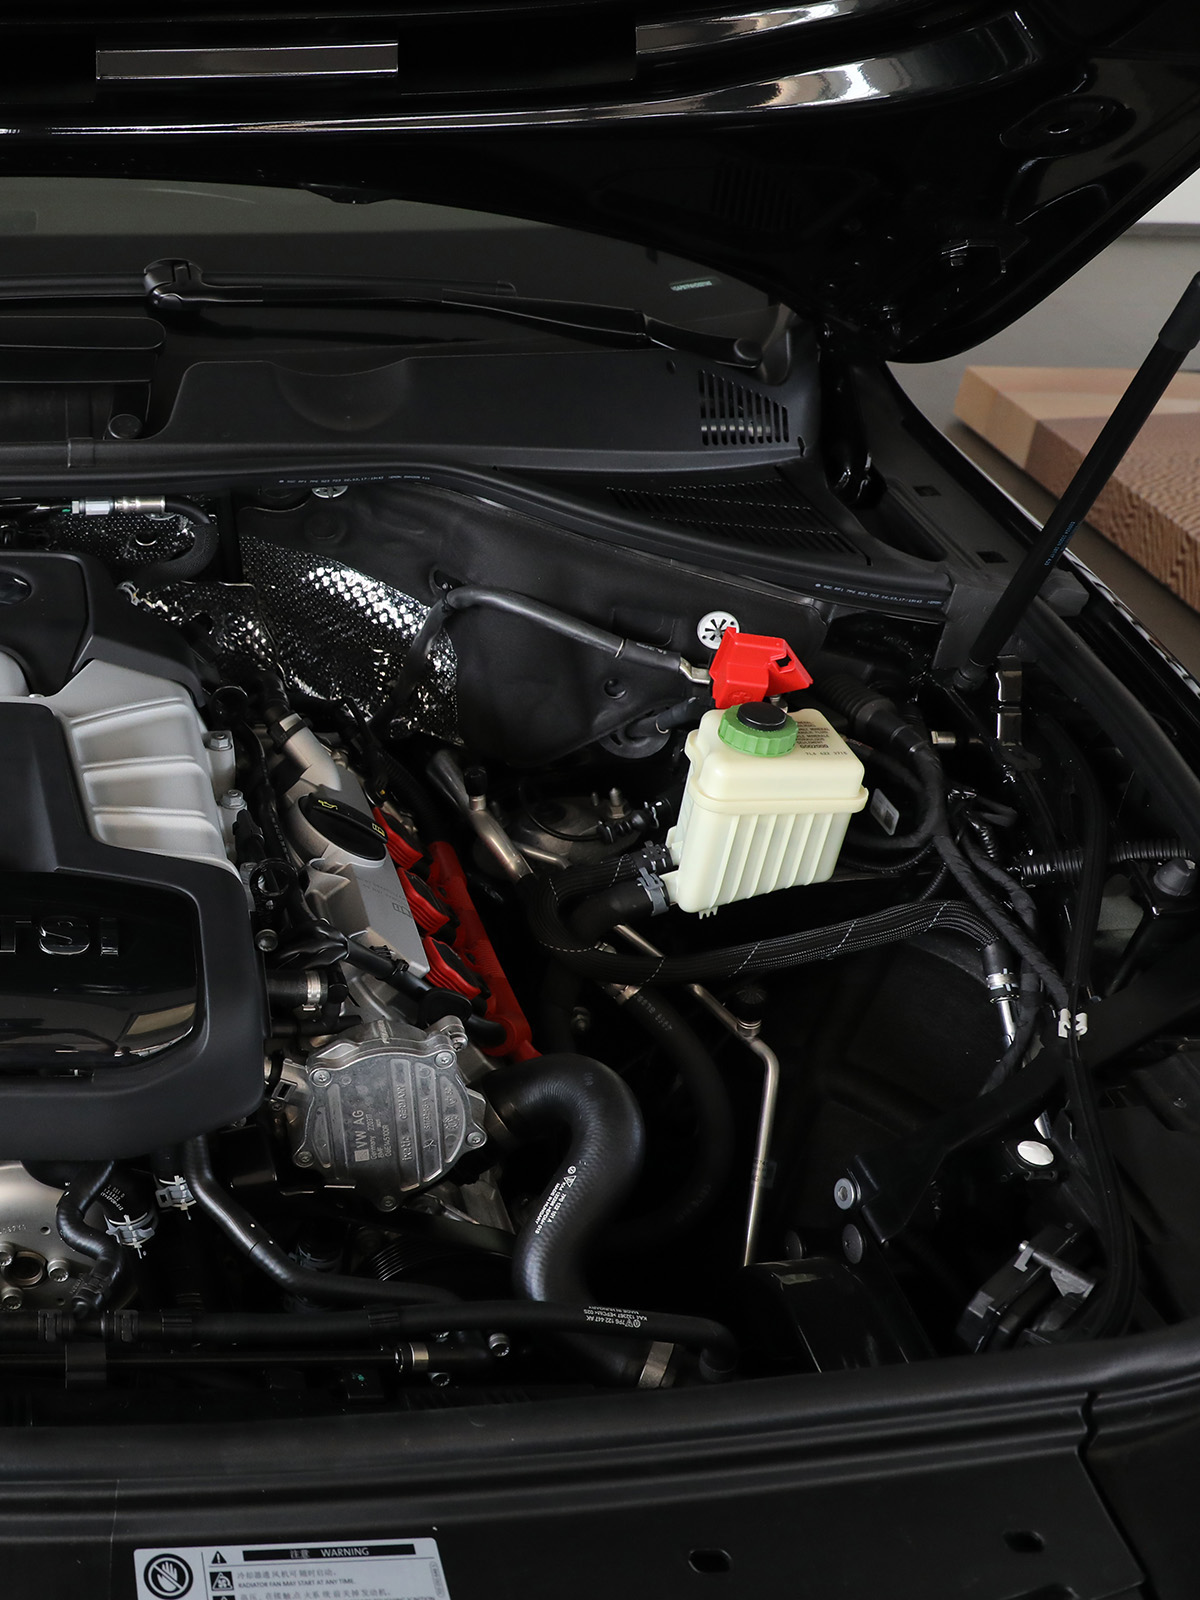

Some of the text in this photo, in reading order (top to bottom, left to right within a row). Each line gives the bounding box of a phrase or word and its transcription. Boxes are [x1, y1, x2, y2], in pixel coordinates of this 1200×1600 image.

[351, 1109, 367, 1148] VW AG
[320, 1547, 370, 1558] WARNING
